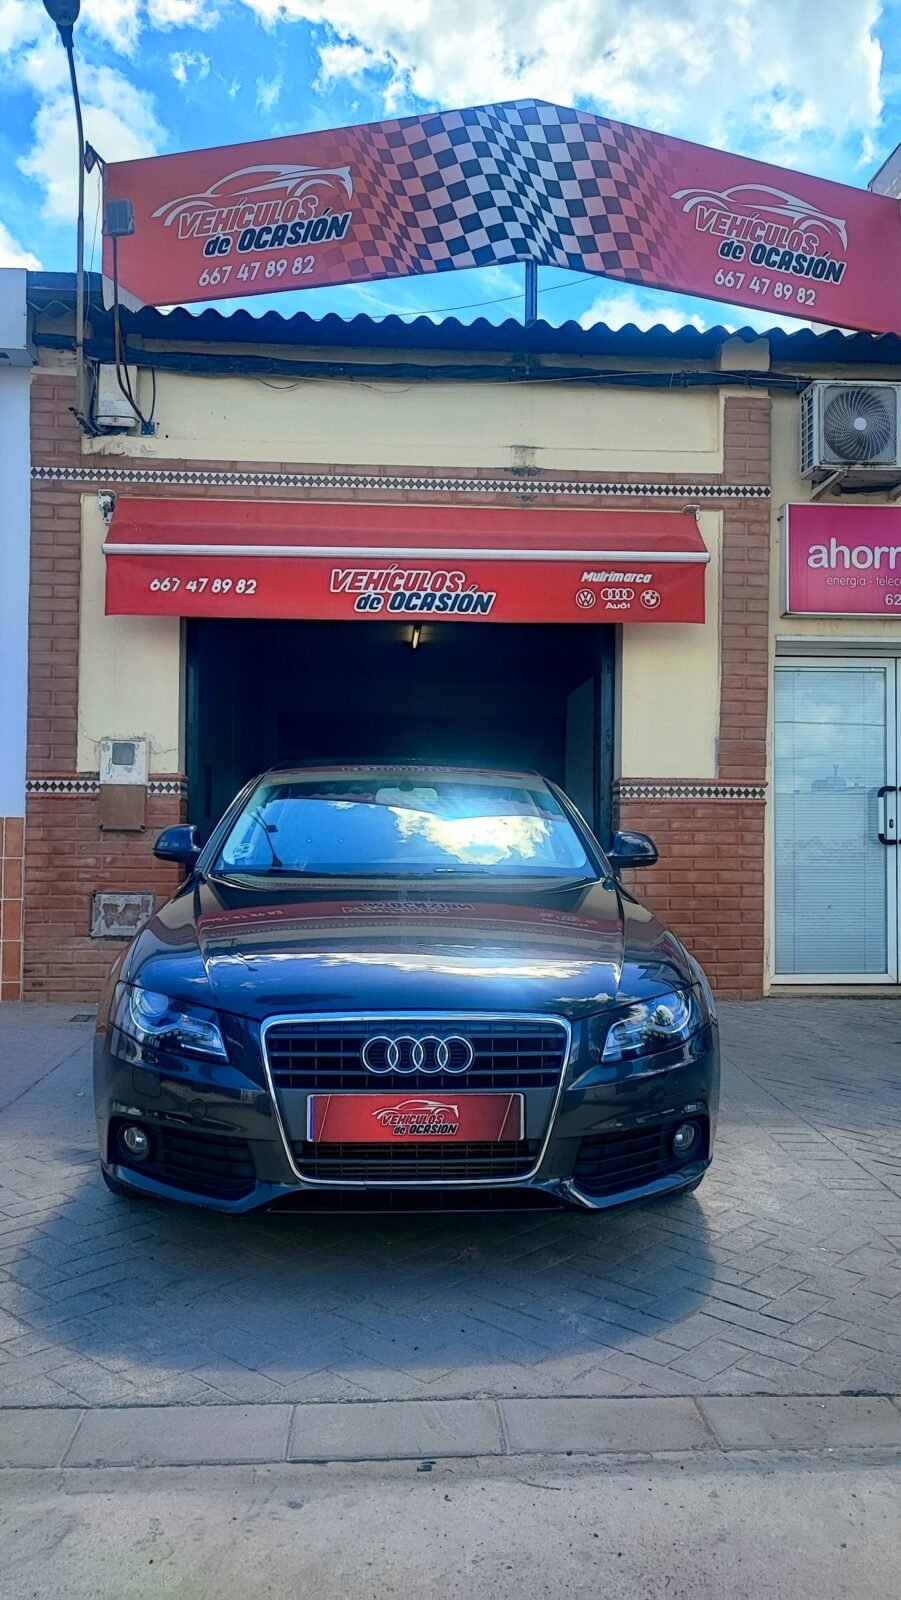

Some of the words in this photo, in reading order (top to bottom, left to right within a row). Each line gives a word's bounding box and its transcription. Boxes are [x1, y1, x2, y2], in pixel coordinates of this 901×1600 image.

[178, 195, 319, 239] VEHÍCULOS
[204, 233, 233, 257] de
[236, 206, 352, 252] OCASIÓN
[695, 205, 820, 256] VEHÍCULOS
[198, 265, 232, 287] 667
[236, 261, 262, 282] 47
[264, 258, 289, 279] 89
[291, 255, 315, 275] 82
[718, 239, 746, 262] de
[749, 243, 847, 285] OCASIÓN
[714, 268, 745, 290] 667
[749, 276, 771, 296] 47
[773, 281, 794, 301] 89
[796, 288, 816, 306] 82
[149, 577, 181, 592] 667
[185, 578, 208, 593] 47
[210, 578, 233, 594] 89
[235, 578, 257, 595] 82
[330, 563, 465, 593] VEHÍCULOS
[876, 575, 901, 587] telec
[354, 592, 384, 613] de
[386, 584, 497, 615] OCASIÓN
[885, 593, 901, 606] 62
[393, 1124, 407, 1135] de
